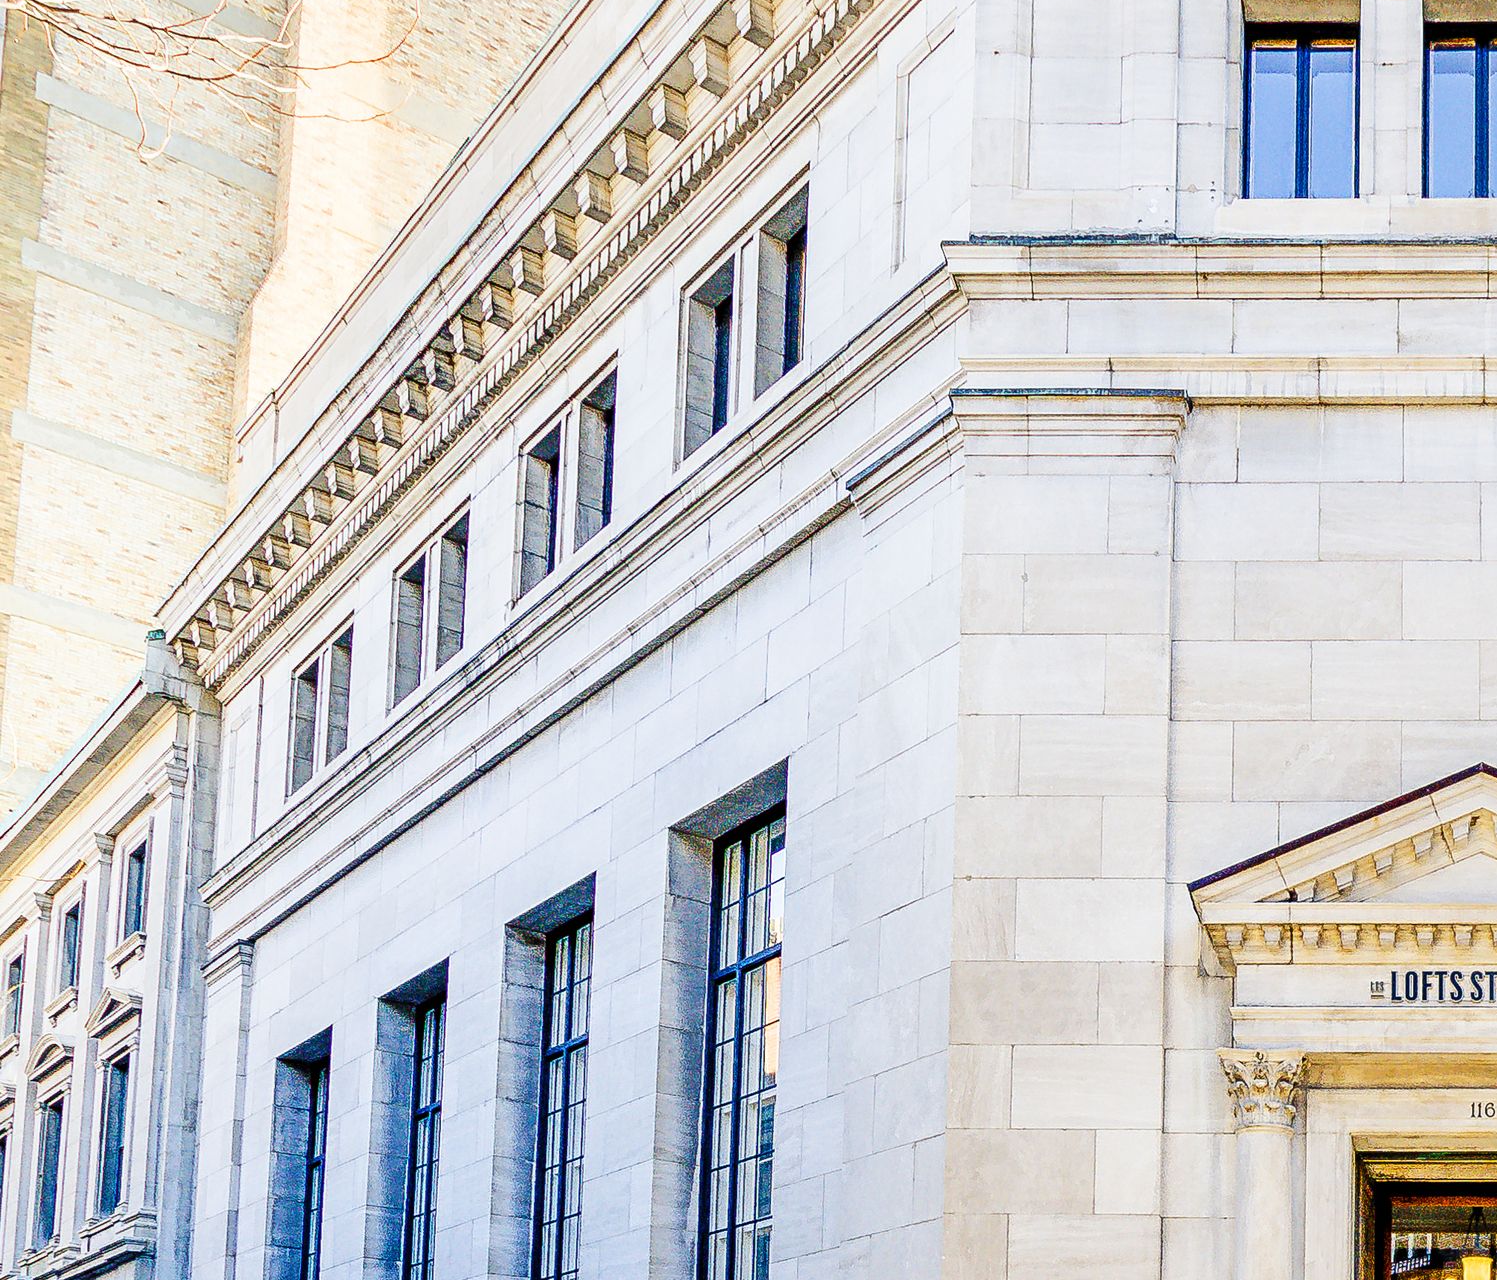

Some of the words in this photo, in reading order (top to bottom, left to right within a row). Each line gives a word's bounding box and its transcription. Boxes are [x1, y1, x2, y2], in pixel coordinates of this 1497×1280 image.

[1370, 980, 1384, 993] LES
[1391, 970, 1464, 1002] LOFTS
[1470, 1102, 1496, 1118] 116
